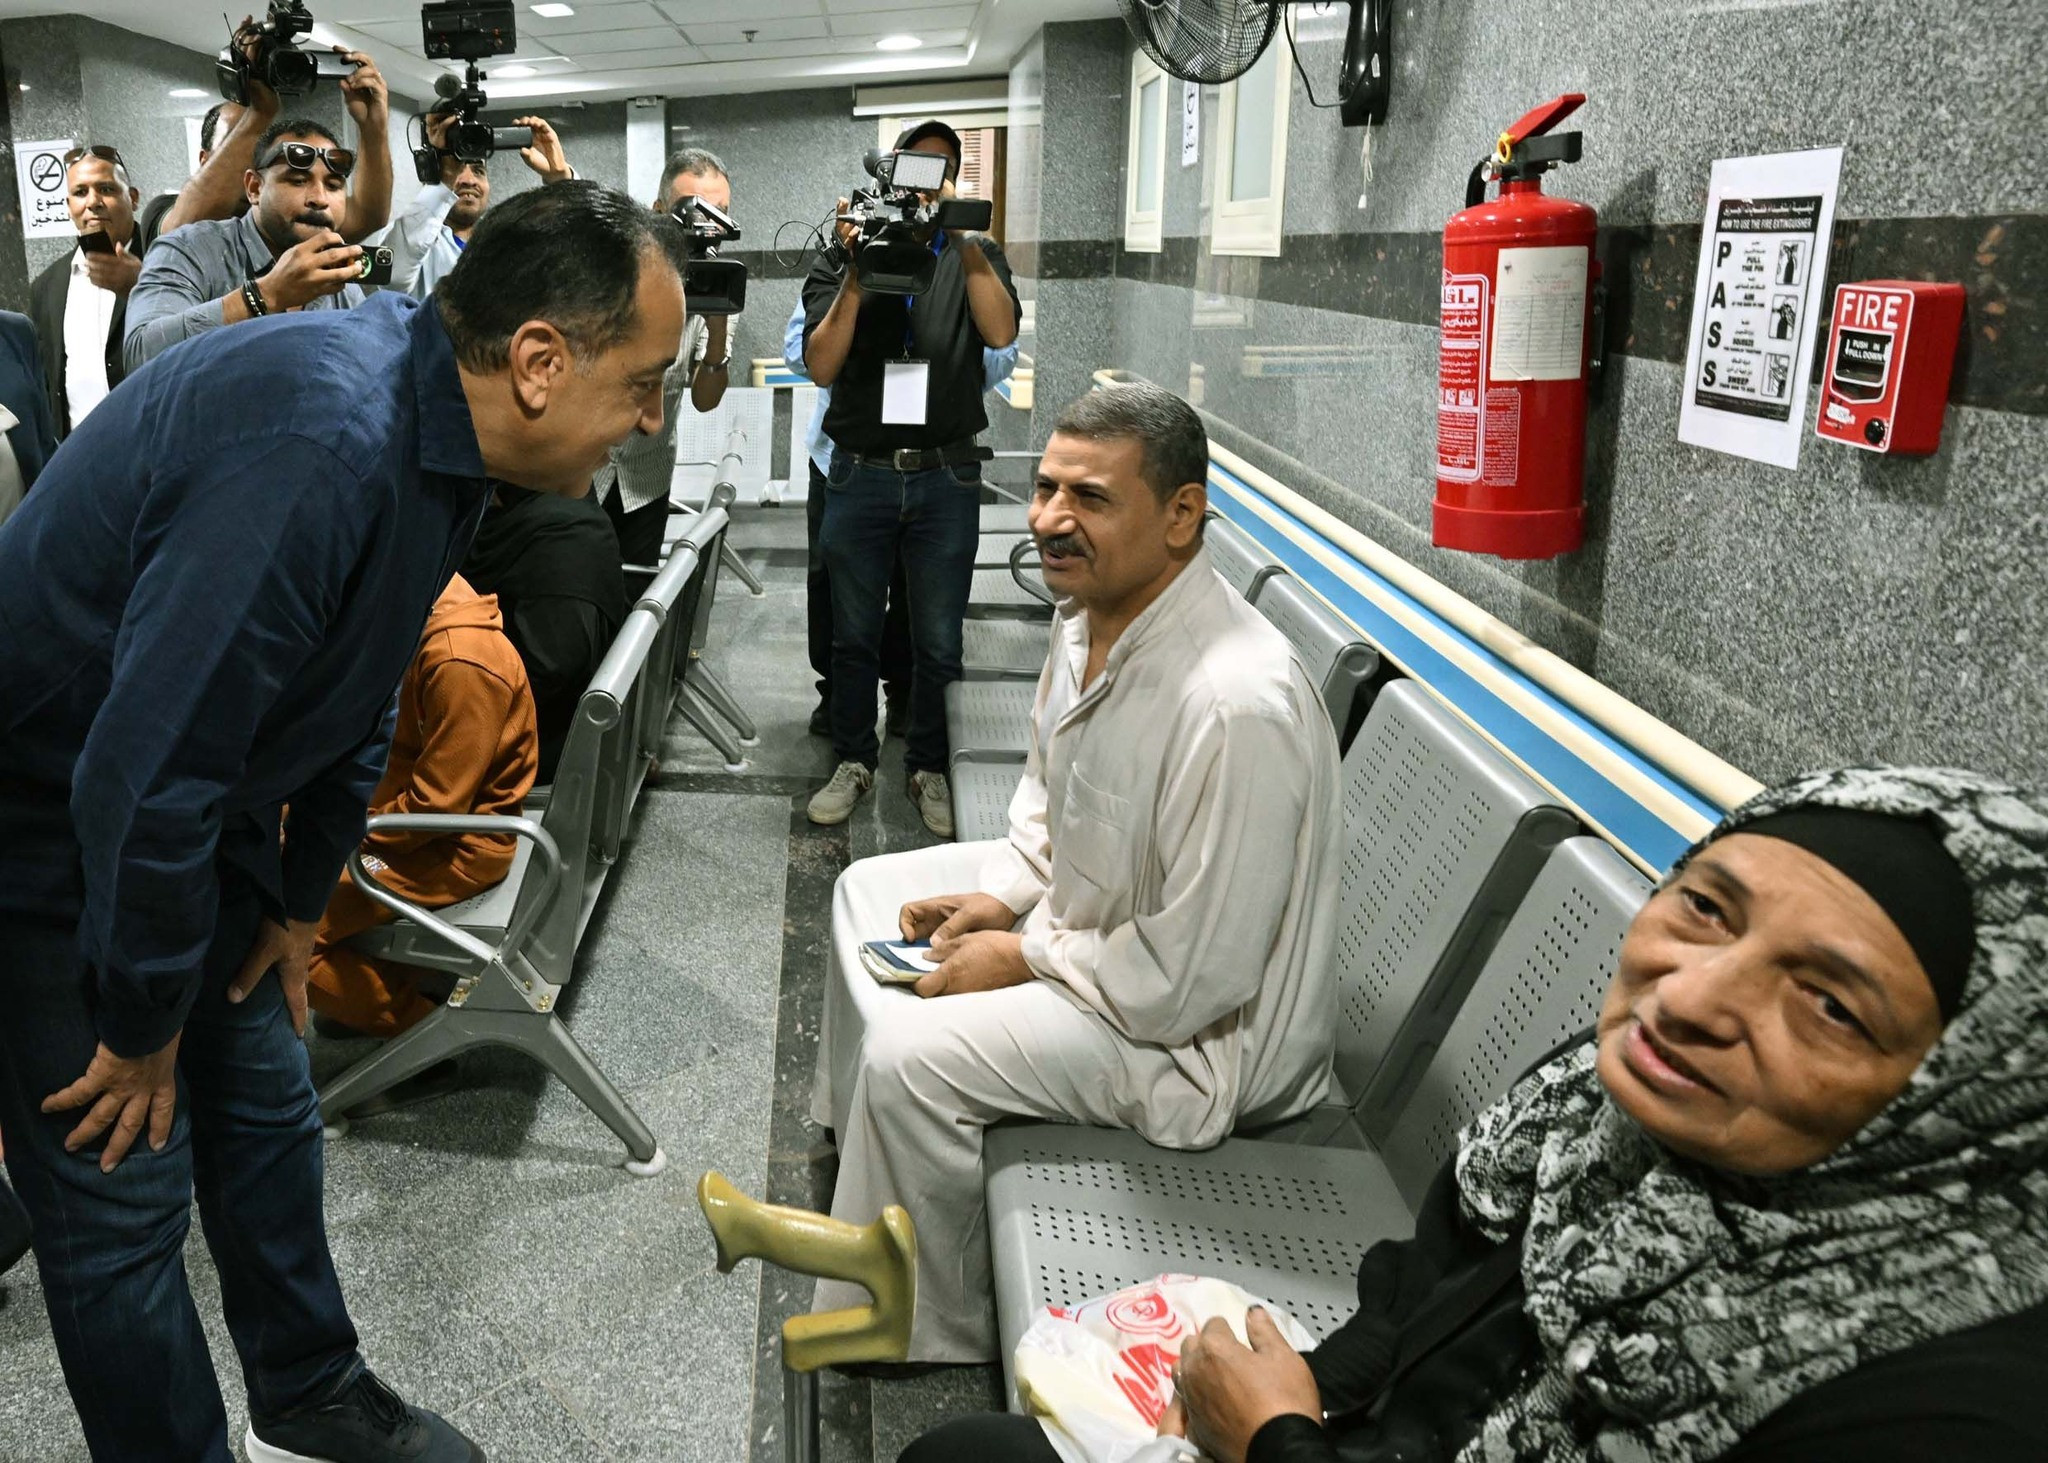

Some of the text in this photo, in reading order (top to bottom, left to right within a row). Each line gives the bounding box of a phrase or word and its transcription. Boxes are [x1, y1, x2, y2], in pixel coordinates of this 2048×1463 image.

[1721, 219, 1732, 230] HOW
[1733, 219, 1740, 229] TO
[1741, 219, 1750, 230] USE
[1751, 219, 1761, 230] THE
[1761, 219, 1773, 230] FIRE
[1717, 241, 1732, 268] P
[1711, 281, 1726, 309] A
[1840, 292, 1903, 330] FIRE
[1707, 321, 1722, 348] S
[1853, 339, 1880, 352] PUSH IN
[1848, 349, 1883, 361] PULL DOWN
[1703, 360, 1717, 387] S
[1728, 376, 1749, 386] SWEEP
